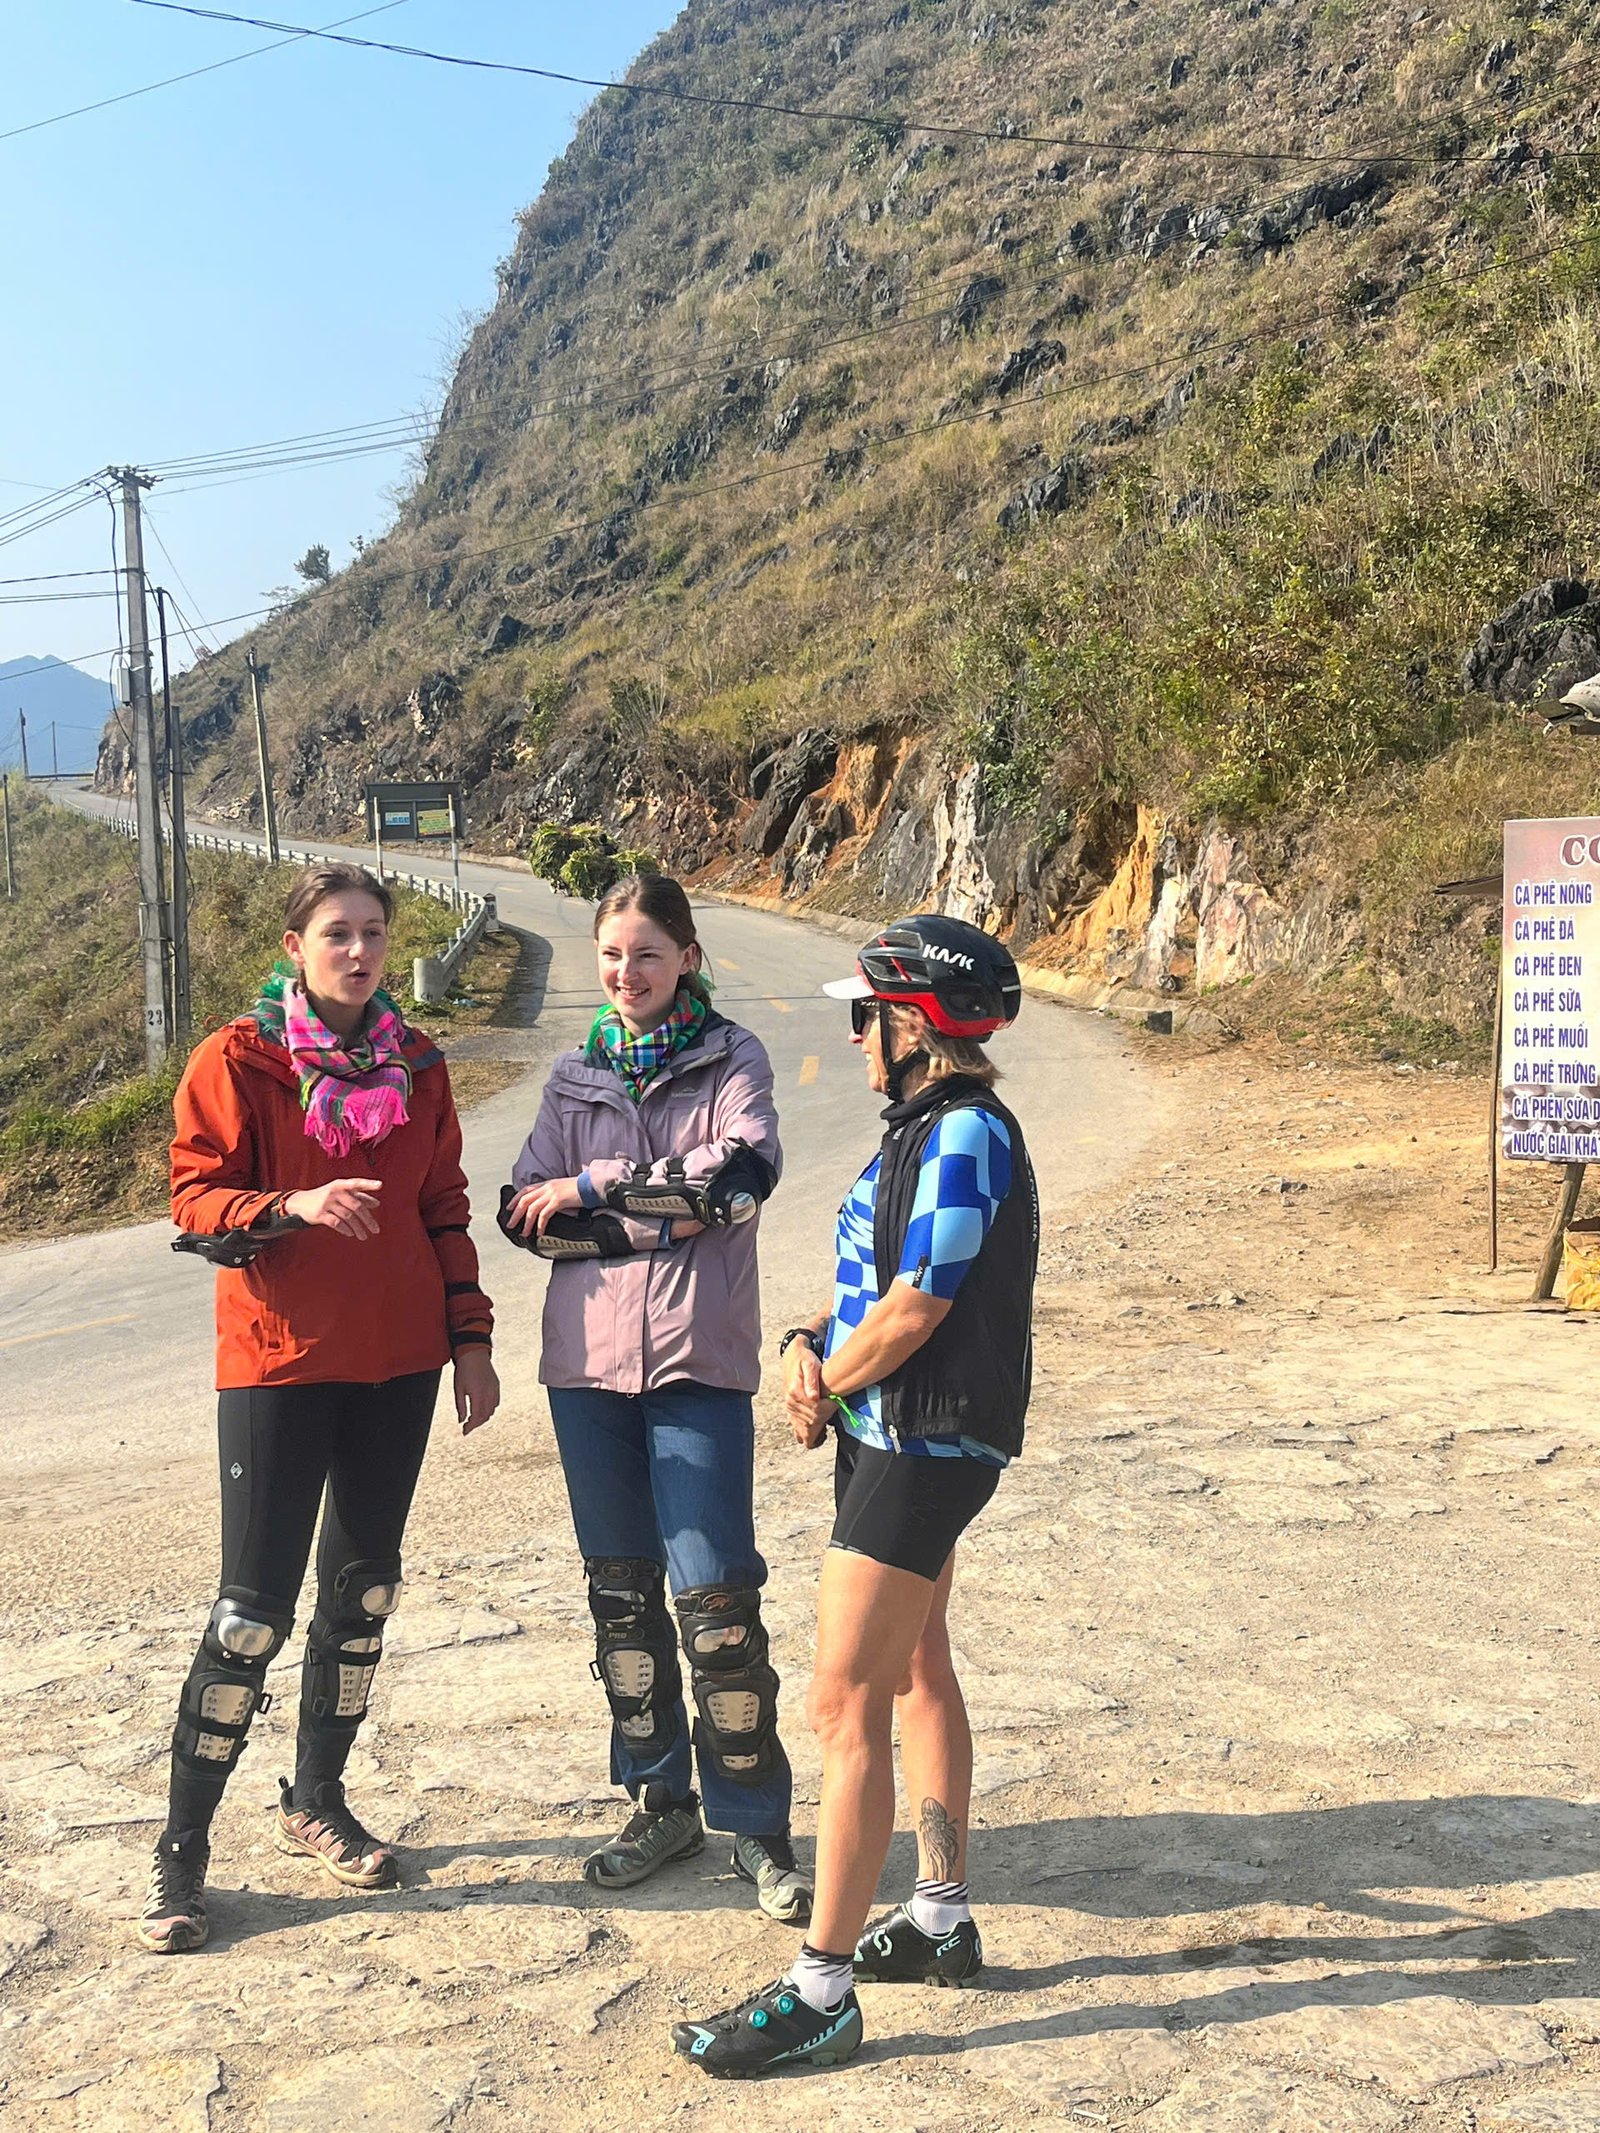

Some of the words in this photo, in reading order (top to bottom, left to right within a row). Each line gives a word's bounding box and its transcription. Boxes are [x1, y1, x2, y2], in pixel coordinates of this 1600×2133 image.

[1534, 880, 1555, 904] PHÊ
[1560, 879, 1592, 904] NÓNG
[1533, 916, 1555, 940] PHÊ
[1559, 915, 1574, 940] ĐÁ
[922, 943, 975, 971] KASK
[1514, 952, 1529, 976] CÀ
[1533, 952, 1555, 976] PHÊ
[1559, 955, 1582, 976] ĐEN
[1514, 986, 1529, 1012] CÀ
[1533, 987, 1554, 1012] PHÊ
[1558, 987, 1581, 1012] SỮA
[147, 1009, 163, 1026] 23
[1514, 1022, 1529, 1047] CÀ
[1533, 1023, 1554, 1047] PHÊ
[1558, 1021, 1588, 1048] MUỐI
[1514, 1058, 1529, 1082] CÀ
[1533, 1059, 1554, 1083] PHÊ
[1558, 1060, 1596, 1084] TRỨNG
[1533, 1094, 1563, 1119] PHÊN
[1567, 1095, 1589, 1120] SỮA
[1514, 1130, 1544, 1154] NƯỚC
[1548, 1127, 1571, 1155] GIẢI
